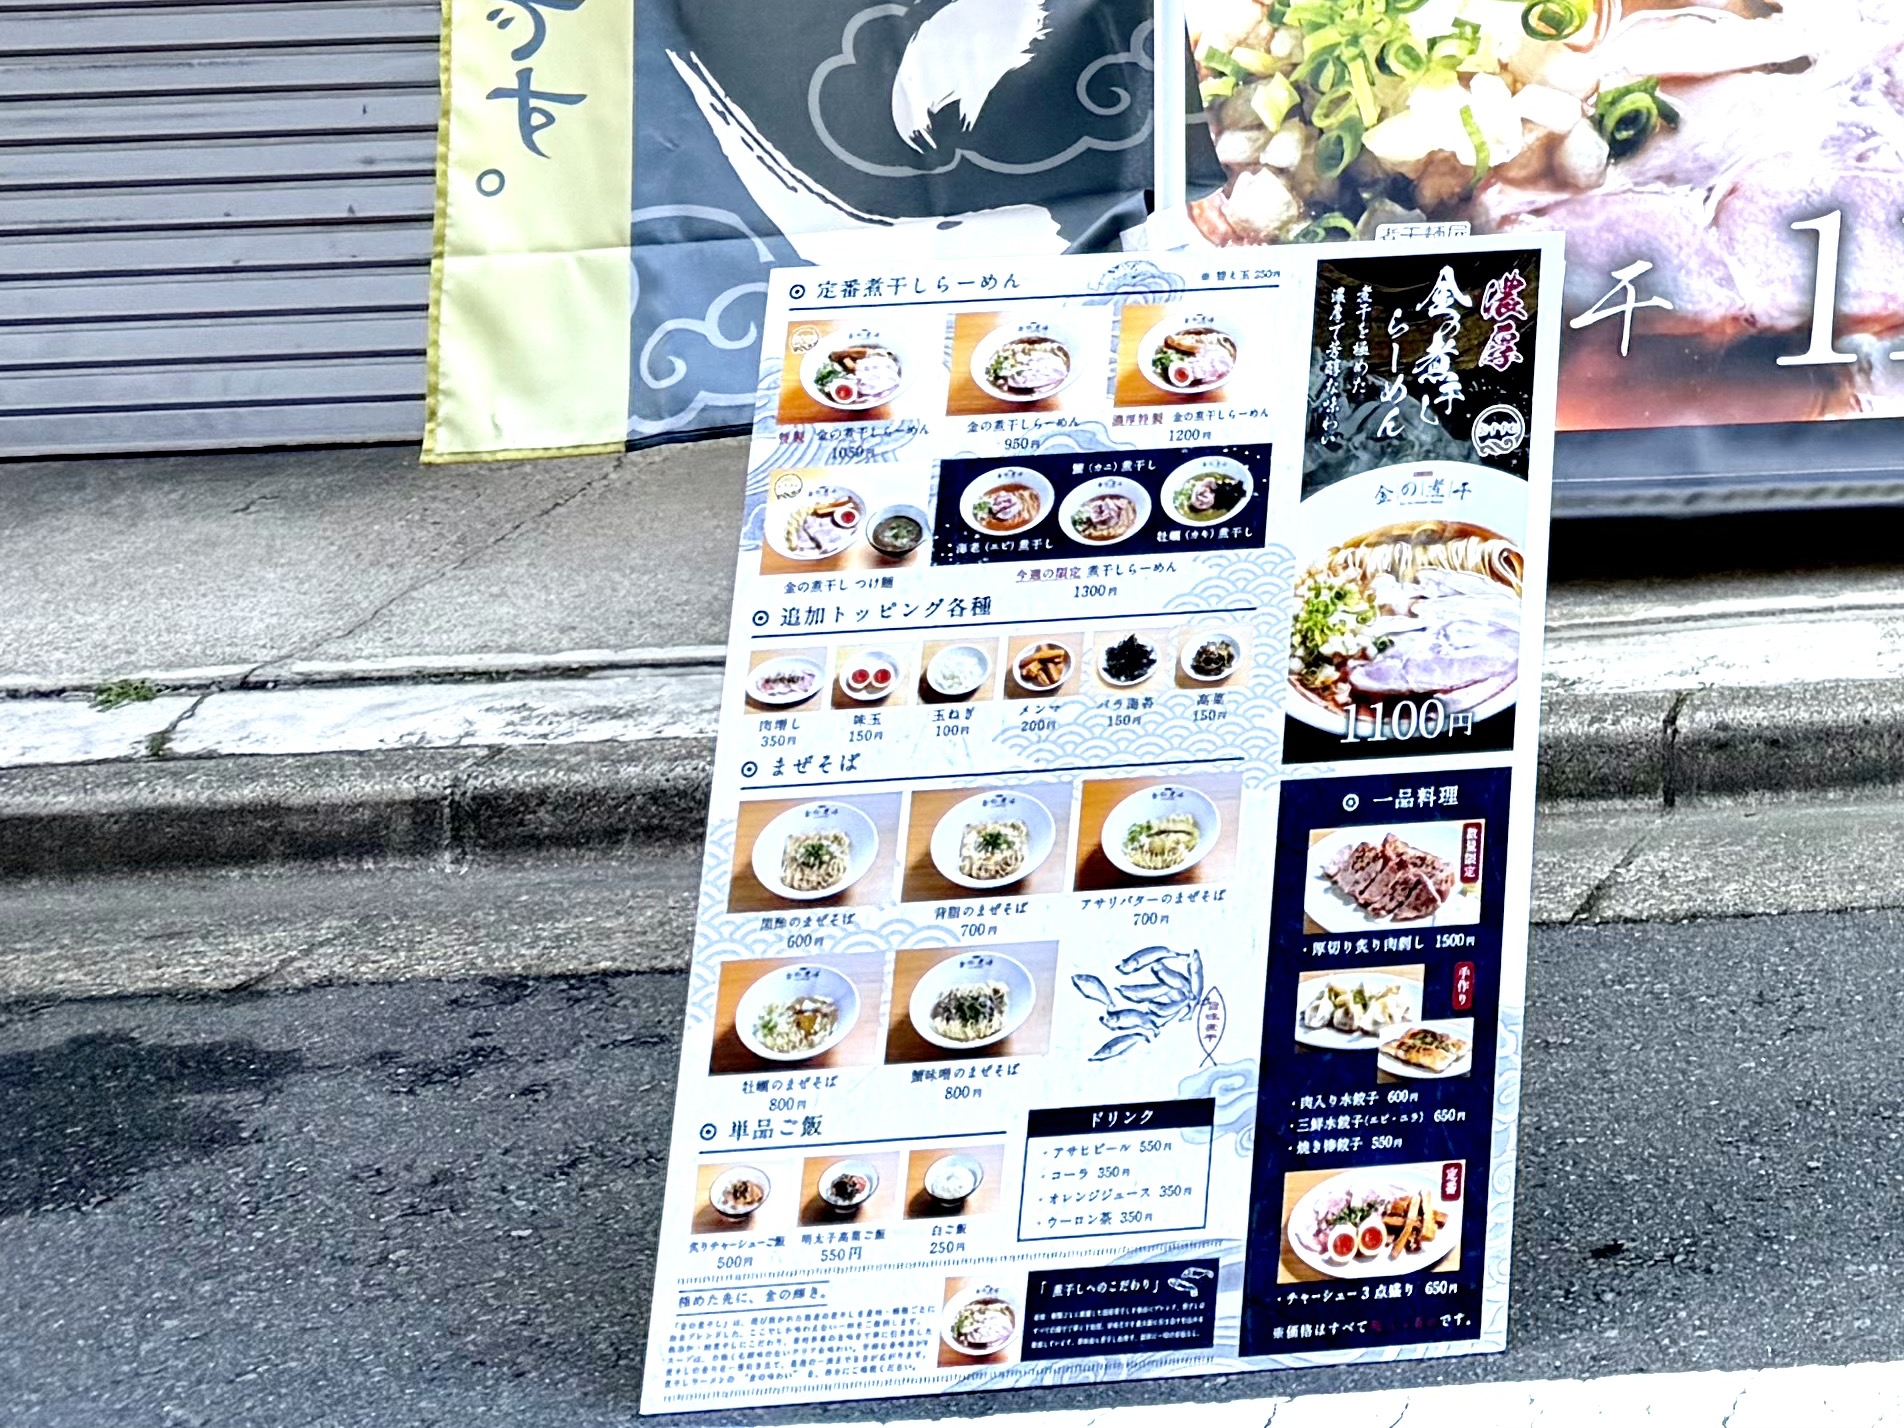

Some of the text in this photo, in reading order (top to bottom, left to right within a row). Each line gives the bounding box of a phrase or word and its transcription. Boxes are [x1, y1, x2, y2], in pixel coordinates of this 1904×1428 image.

[816, 273, 1021, 299] 定番煮干しらーめん
[1478, 268, 1529, 372] 濃厚
[1411, 265, 1474, 427] 金の煮干し
[1376, 308, 1411, 439] らーめん
[1169, 428, 1212, 442] 1200円
[1073, 585, 1118, 599] 1300円
[780, 596, 993, 627] 追加トッピング各種
[935, 724, 970, 737] 100円
[1339, 698, 1473, 744] 1100円
[771, 752, 862, 777] まぜそば
[1372, 784, 1459, 809] 一品料理
[1133, 912, 1169, 926] 700円
[728, 1114, 824, 1142] 単品ご飯
[1091, 1109, 1154, 1129] ドリンク
[1051, 1168, 1090, 1182] コーラ
[820, 1244, 863, 1263] 550円
